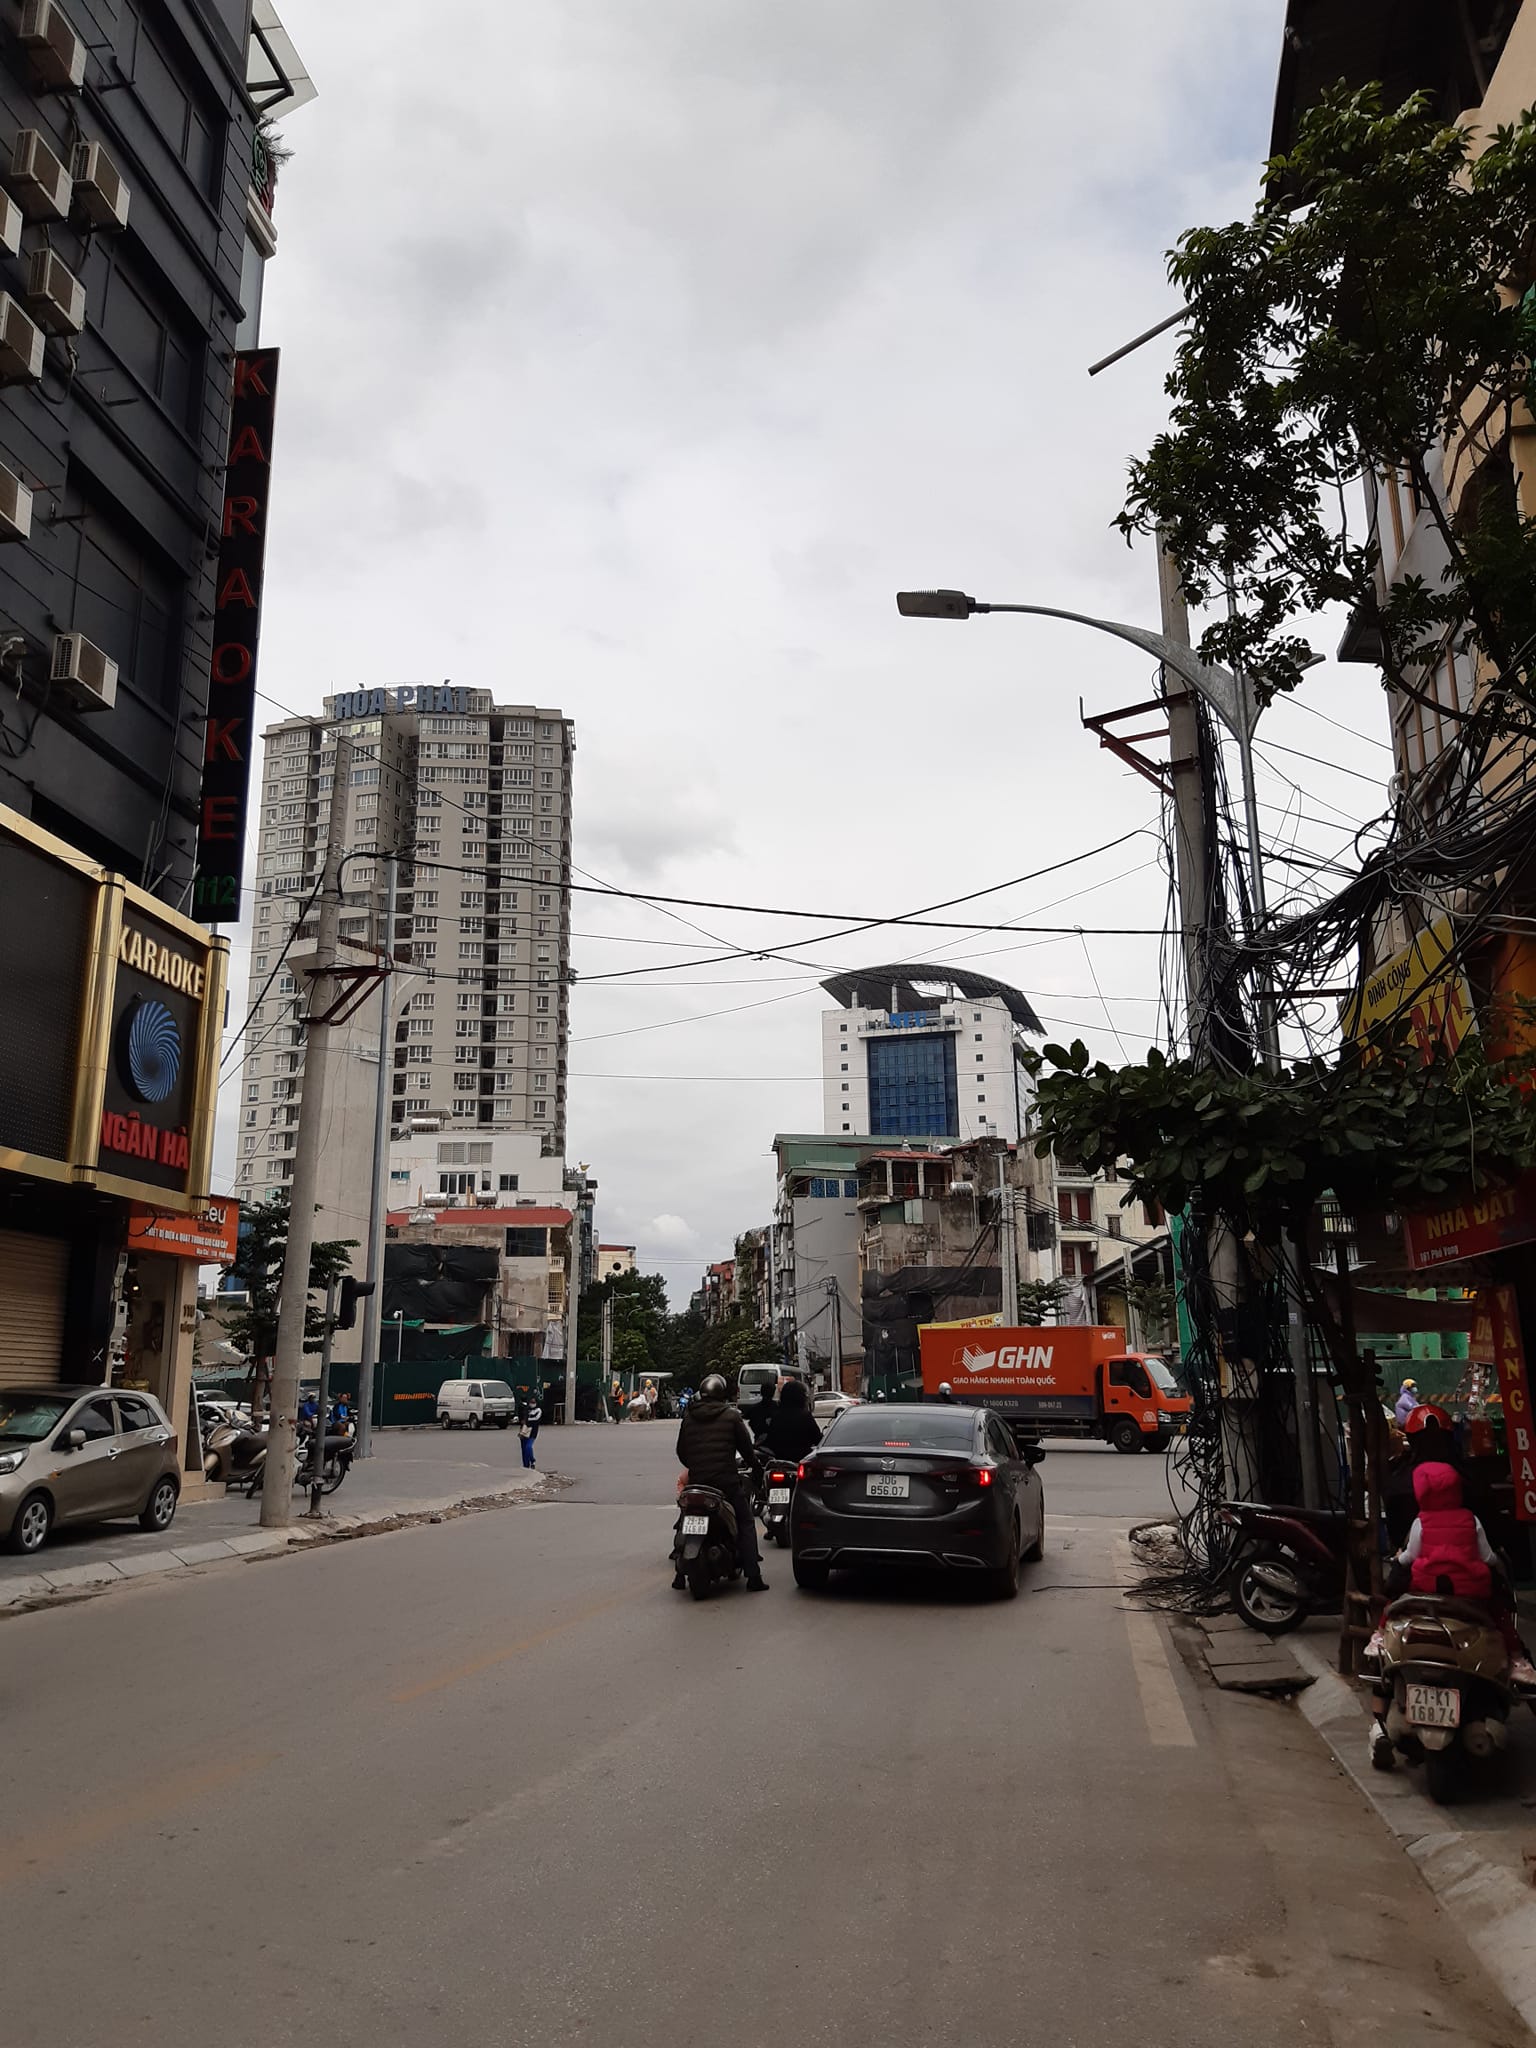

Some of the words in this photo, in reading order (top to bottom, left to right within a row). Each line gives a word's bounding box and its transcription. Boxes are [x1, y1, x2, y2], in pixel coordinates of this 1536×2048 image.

[201, 358, 271, 842] KARAOKE
[195, 874, 239, 905] 112
[119, 925, 206, 1002] KARAOKE
[101, 1110, 159, 1161] NGÂN
[159, 1126, 189, 1171] HÀ
[1426, 1202, 1470, 1241] NHÀ
[997, 1346, 1054, 1369] GHN
[1495, 1291, 1526, 1413] VÀNG
[952, 1376, 969, 1384] GIAO
[969, 1375, 990, 1384] HÀNG
[990, 1376, 1016, 1385] NHANH
[1016, 1375, 1035, 1385] TOÀN
[1036, 1374, 1057, 1387] QUỐC
[878, 1475, 897, 1485] 30G
[1514, 1427, 1536, 1514] BẠC
[870, 1485, 904, 1496] 856.07
[1414, 1688, 1450, 1707] 21-K1
[1411, 1704, 1456, 1724] 168.74
